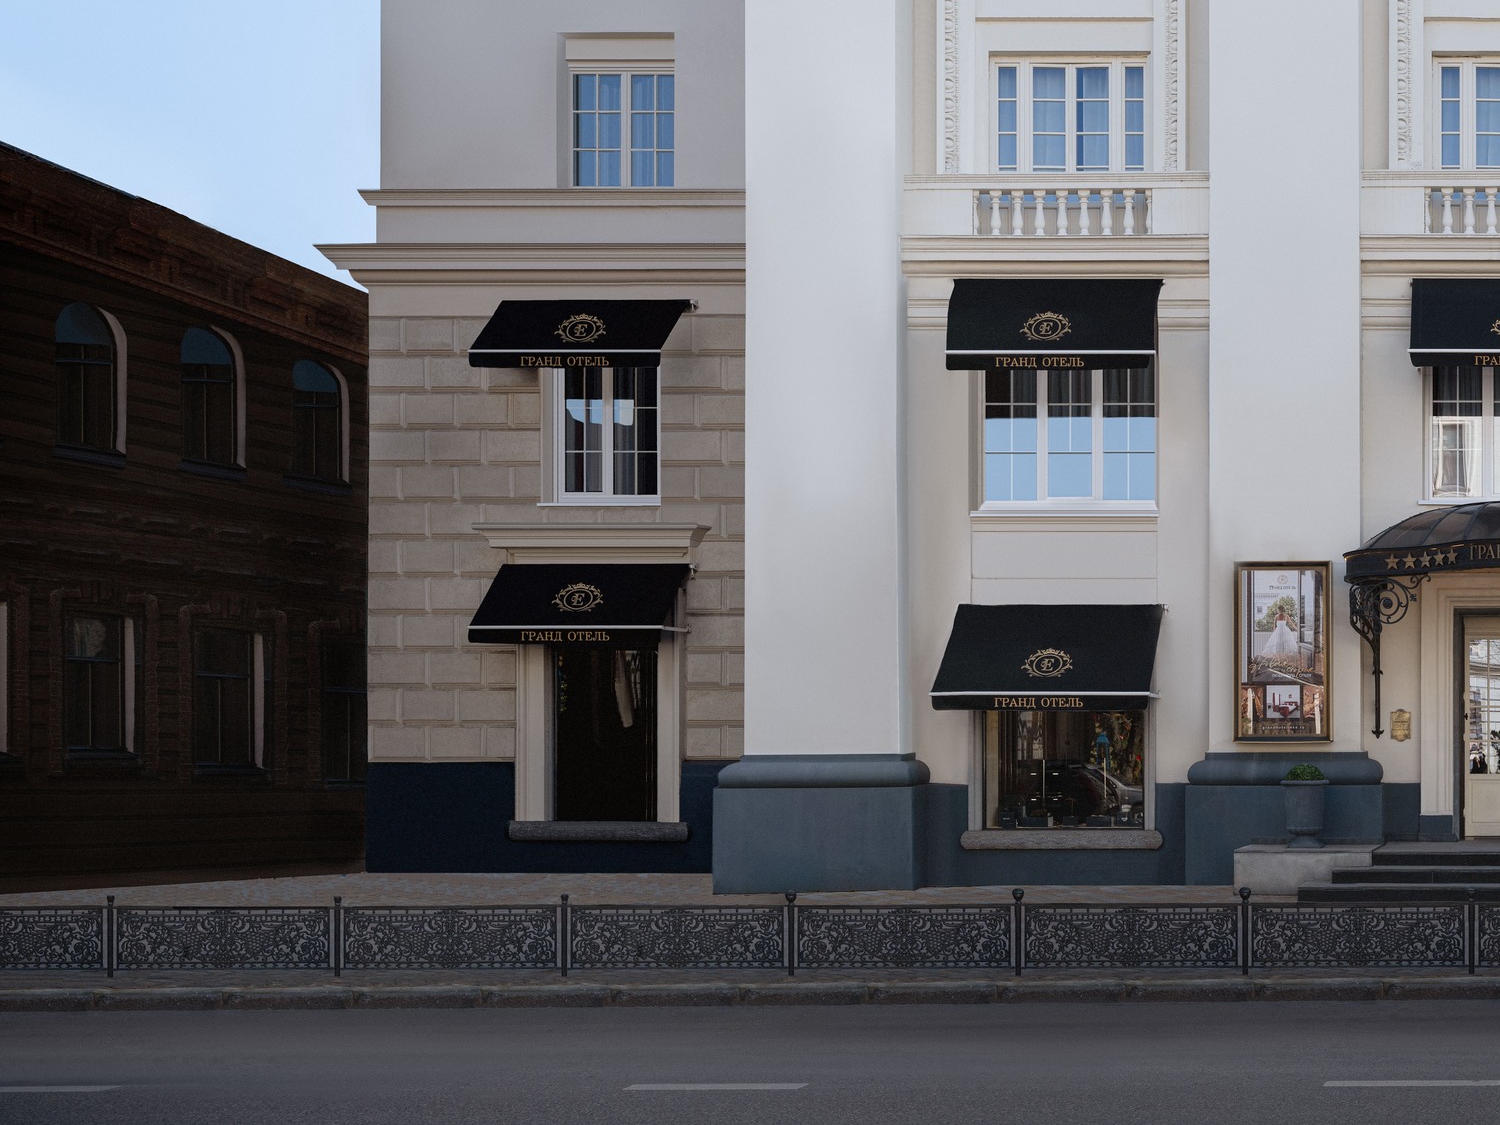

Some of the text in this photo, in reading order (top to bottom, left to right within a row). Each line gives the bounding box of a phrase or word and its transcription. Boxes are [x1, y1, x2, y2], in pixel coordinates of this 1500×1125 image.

[520, 356, 610, 367] ГРАНД ОТЕЛЬ
[995, 357, 1085, 368] ГРАНД ОТЕЛЬ
[521, 631, 610, 642] ГРАНД ОТЕЛЬ
[994, 697, 1084, 709] ГРАНД ОТЕЛЬ
